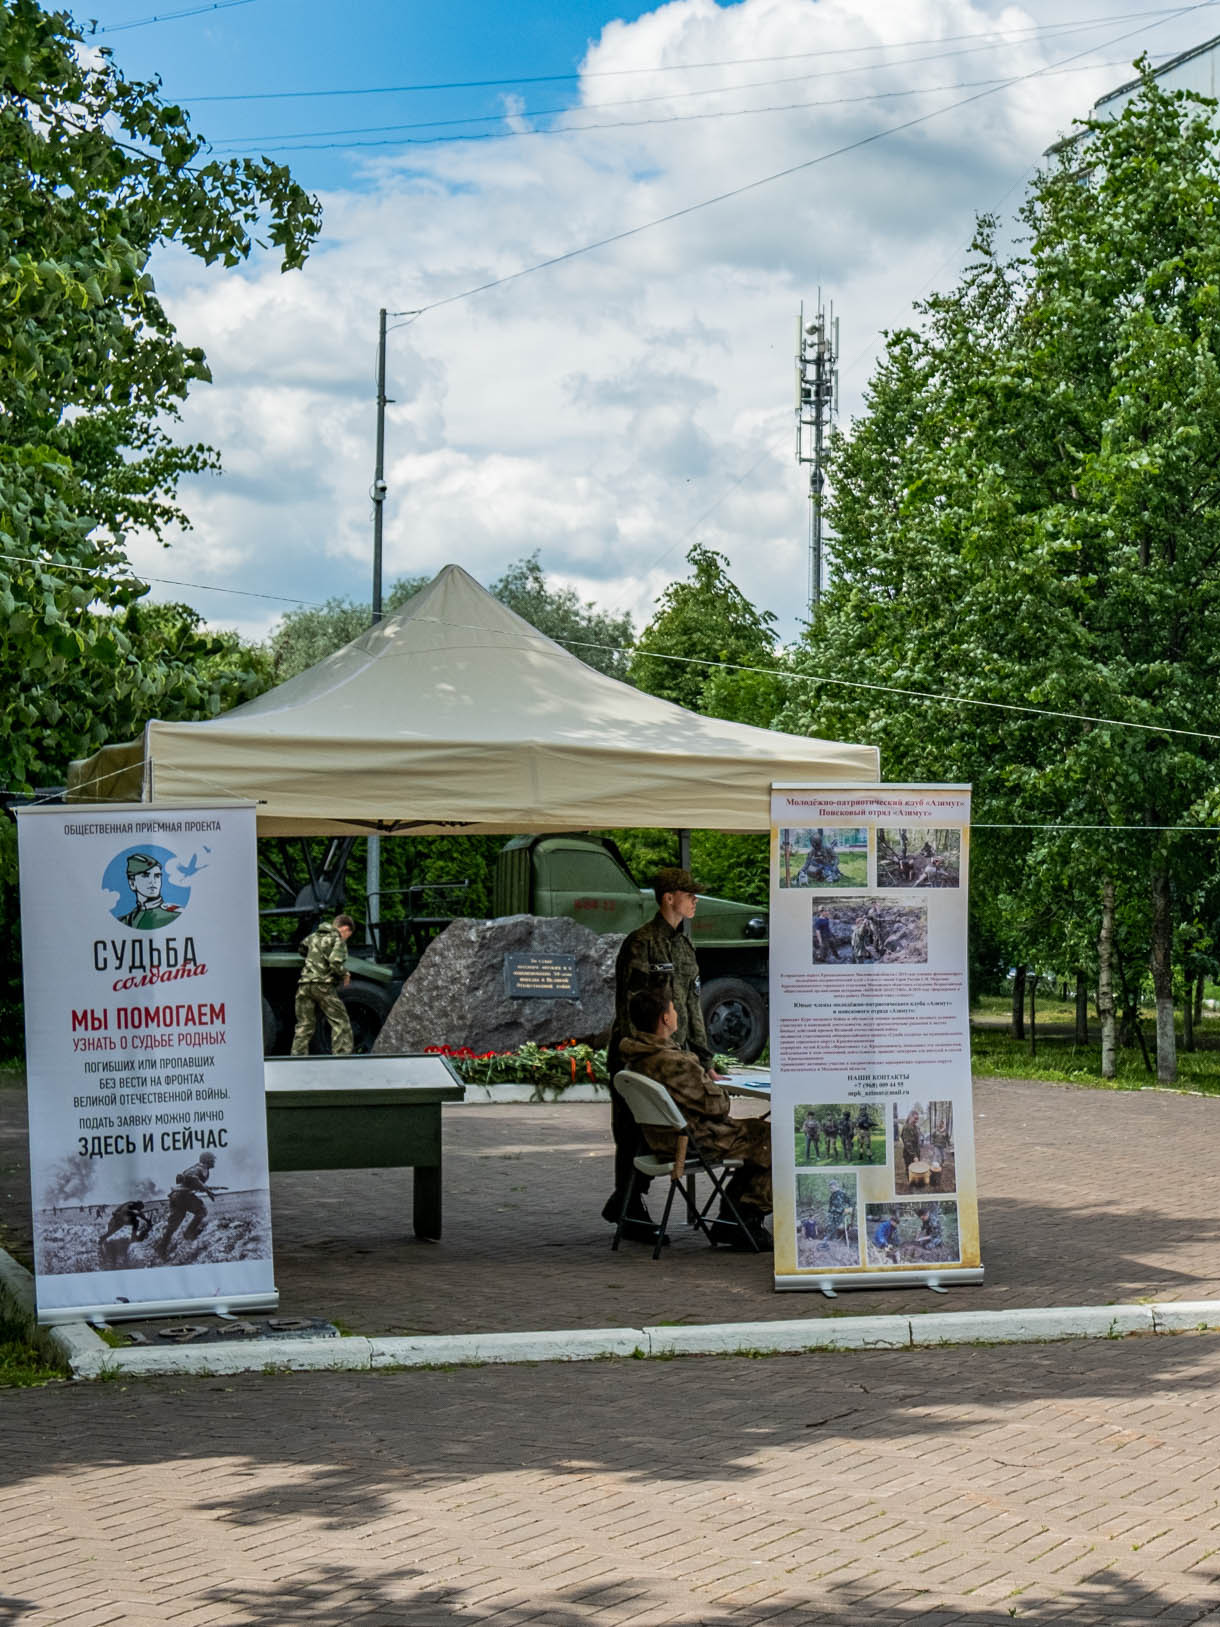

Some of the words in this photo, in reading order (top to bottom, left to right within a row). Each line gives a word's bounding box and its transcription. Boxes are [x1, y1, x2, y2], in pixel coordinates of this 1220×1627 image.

[64, 823, 133, 837] ОБЩЕСТВЕННАЯ
[184, 820, 222, 832] ПРОЕКТА
[93, 936, 198, 974] СУДЬБА
[112, 960, 208, 992] солдата
[71, 1008, 108, 1032] МЫ
[116, 1002, 226, 1030] ПОМОГАЕМ
[72, 1035, 117, 1053] УЗНАТЬ
[120, 1036, 128, 1050] О
[131, 1033, 174, 1051] СУДЬБЕ
[178, 1031, 226, 1049] РОДНЫХ
[84, 1058, 136, 1073] ПОГИБШИХ
[138, 1058, 157, 1071] ИЛИ
[159, 1056, 215, 1070] ПРОПАВШИХ
[99, 1077, 116, 1090] БЕЗ
[119, 1076, 148, 1089] ВЕСТИ
[150, 1075, 162, 1087] НА
[164, 1073, 205, 1086] ФРОНТАХ
[73, 1092, 117, 1108] ВЕЛИКОЙ
[119, 1089, 193, 1106] ОТЕЧЕСТВЕННОЙ
[195, 1087, 231, 1102] ВОЙНЫ.
[79, 1117, 115, 1131] ПОДАТЬ
[117, 1114, 153, 1127] ЗАЯВКУ
[155, 1111, 191, 1126] МОЖНО
[193, 1110, 224, 1123] ЛИЧНО
[78, 1134, 137, 1159] ЗДЕСЬ
[142, 1132, 155, 1153] И
[160, 1126, 229, 1152] СЕЙЧАС
